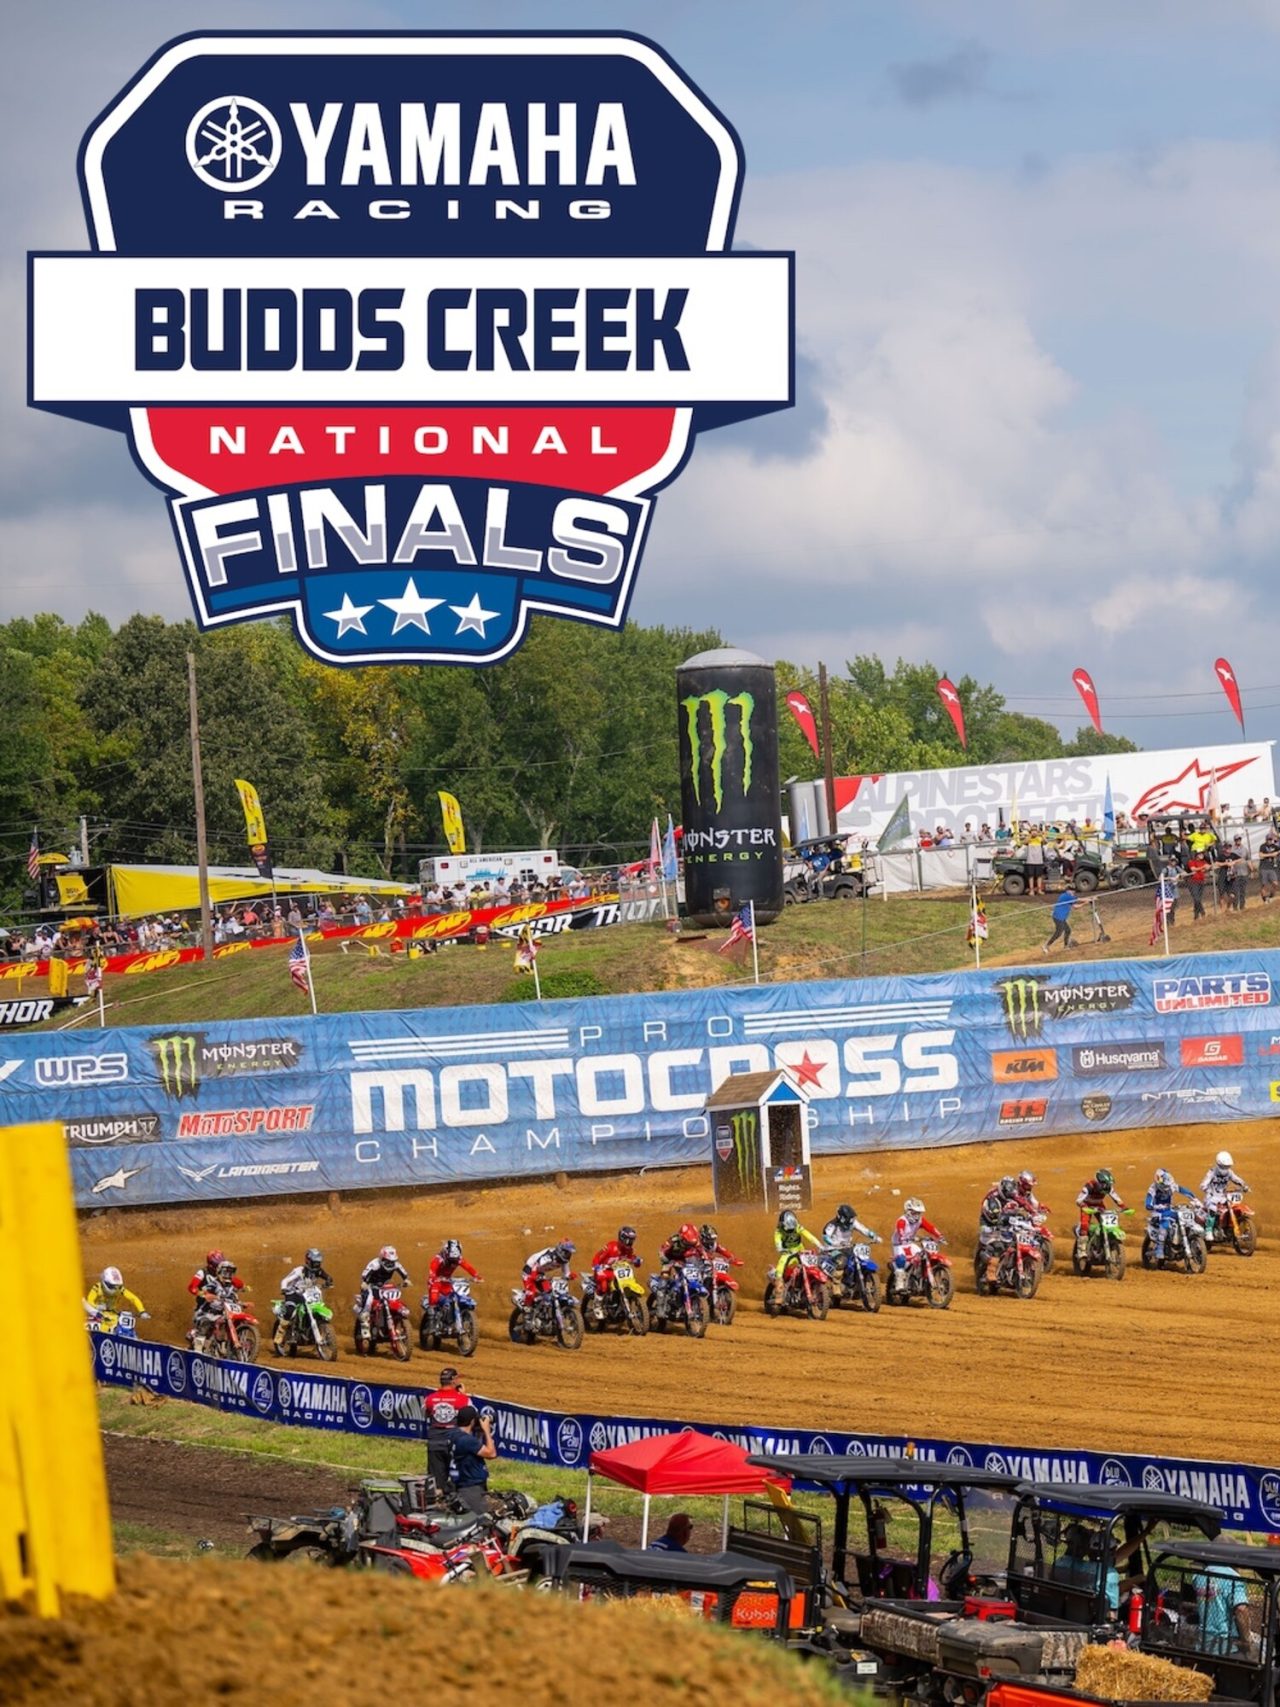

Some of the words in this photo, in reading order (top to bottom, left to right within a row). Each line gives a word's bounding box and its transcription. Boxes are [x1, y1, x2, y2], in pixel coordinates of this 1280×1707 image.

[852, 760, 1092, 812] ALPINESTARS
[1044, 985, 1130, 1003] MONSTER
[1155, 973, 1269, 999] PARTS
[1057, 1001, 1116, 1012] ENERGY
[1156, 992, 1269, 1012] UNLIMITED
[580, 1016, 733, 1047] PRO
[202, 1041, 296, 1062] MONSTER
[1096, 1049, 1160, 1066] Husqvarna
[36, 1053, 127, 1084] WPS
[217, 1058, 282, 1070] ENERGY
[1005, 1059, 1044, 1074] KTM
[350, 1029, 960, 1134] MOTOCROSS
[1001, 1101, 1046, 1117] ETS
[355, 1097, 961, 1163] CHAMPIOSHIP
[122, 1316, 134, 1326] 91
[115, 1342, 162, 1377] YAMAHA
[292, 1380, 347, 1414] YAMAHA
[283, 1409, 344, 1424] RACING
[497, 1409, 550, 1448] YAMAHA
[498, 1441, 548, 1459] ACING
